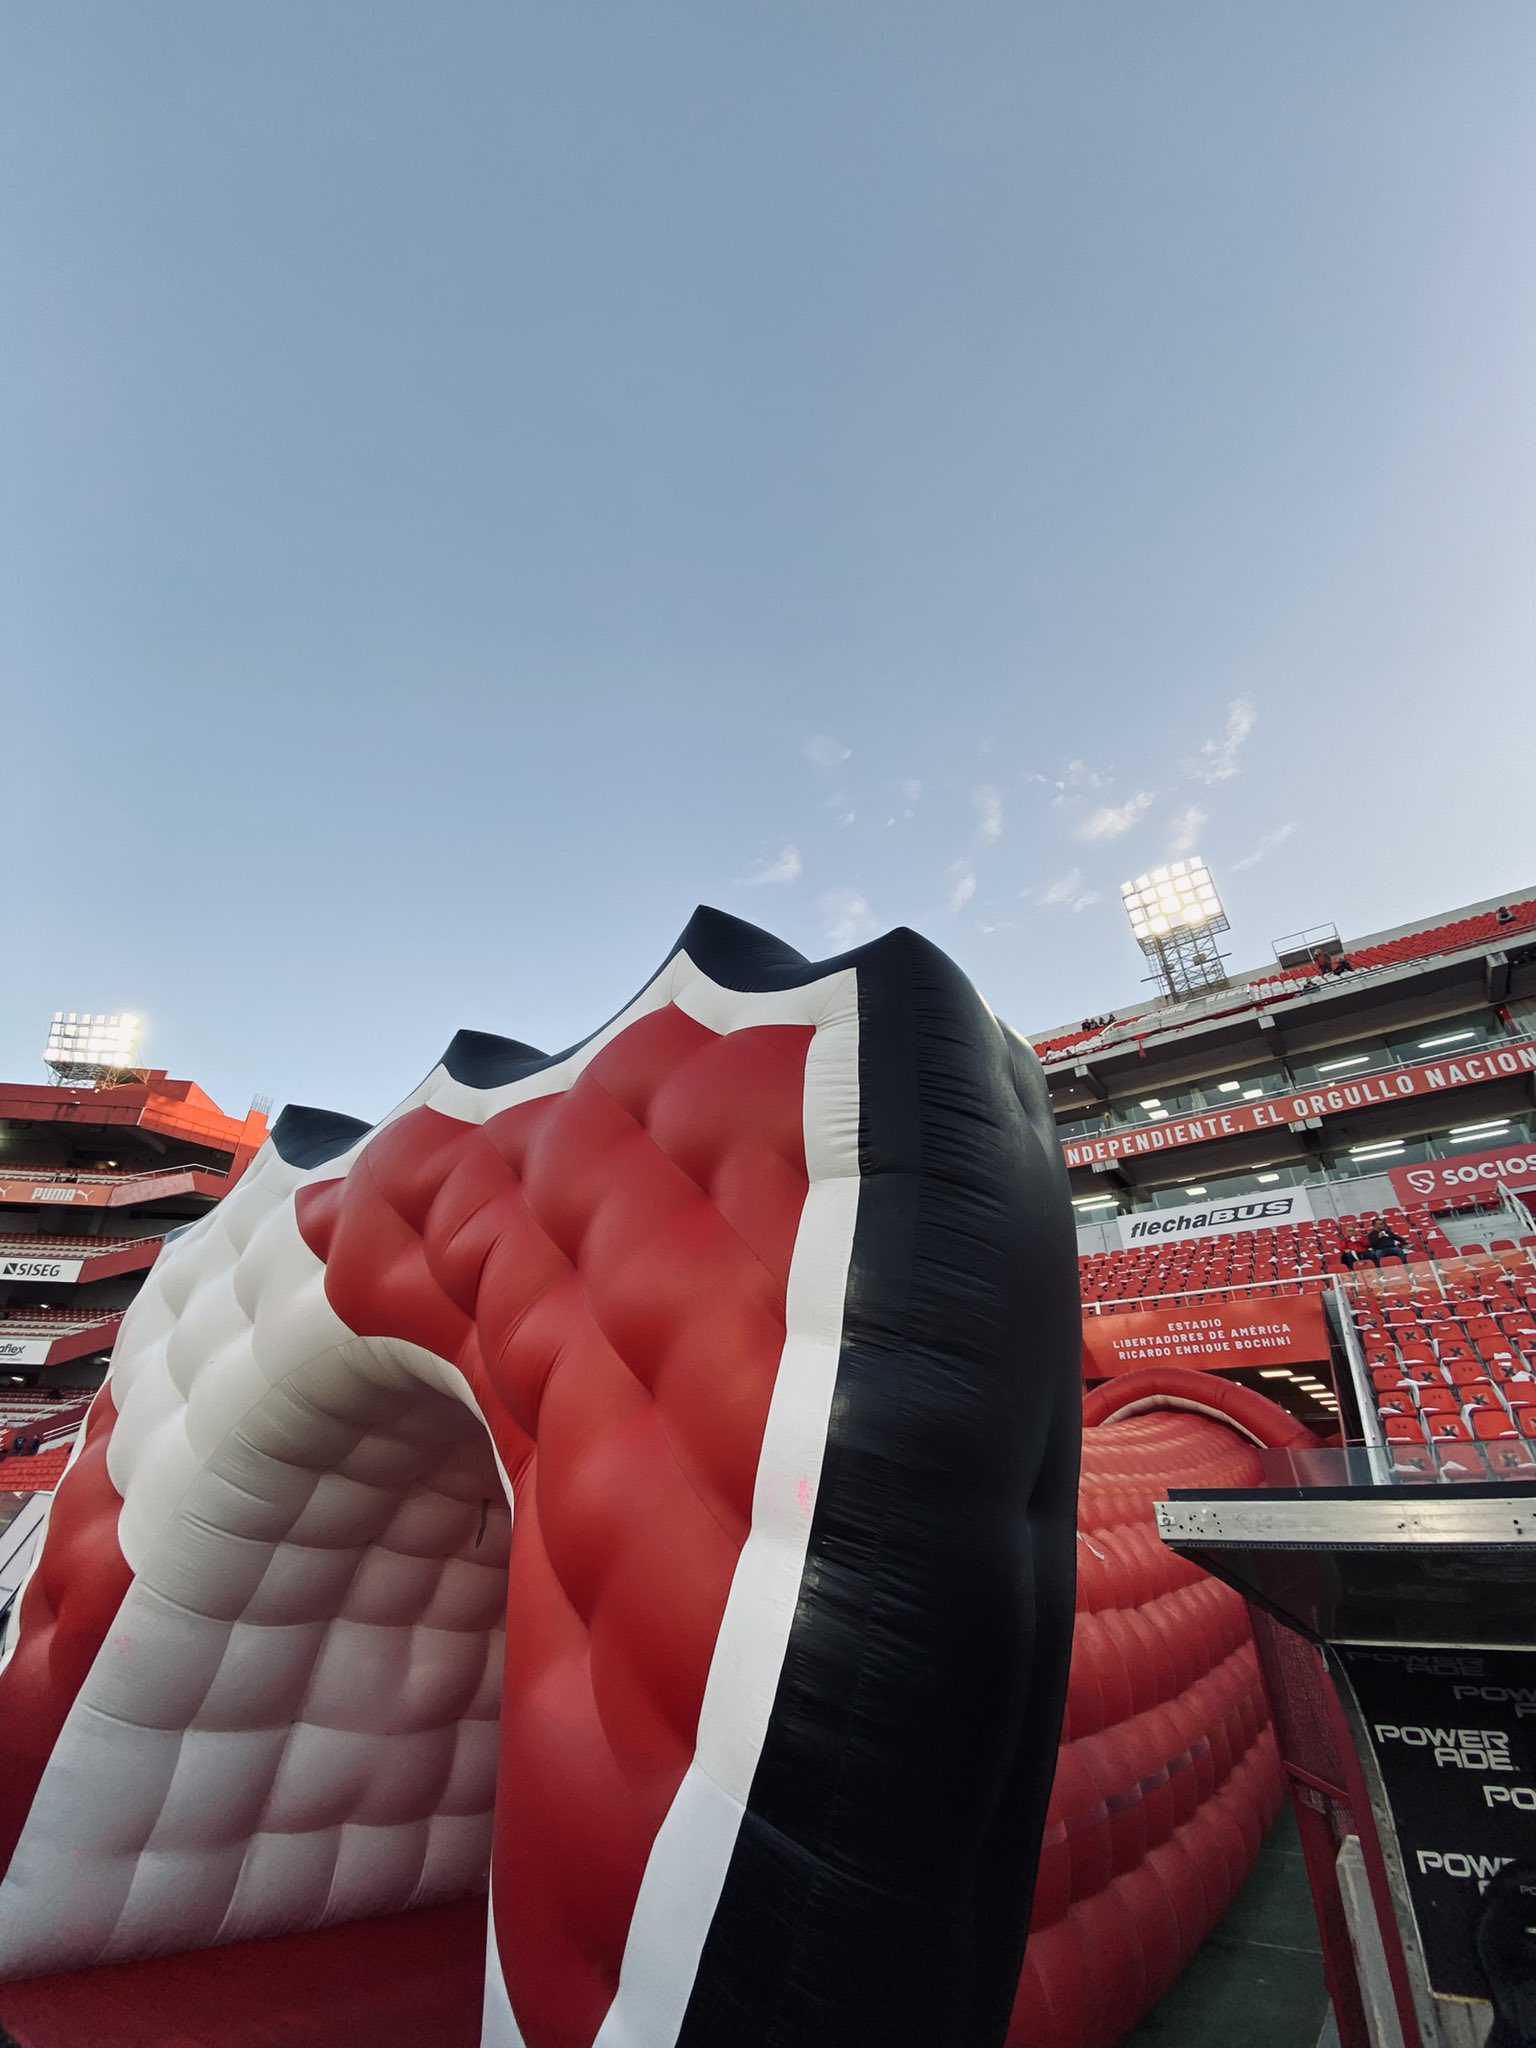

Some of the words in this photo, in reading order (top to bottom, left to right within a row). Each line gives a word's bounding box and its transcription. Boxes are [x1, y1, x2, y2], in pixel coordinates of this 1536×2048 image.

[1252, 1105, 1284, 1126] EL
[1293, 1075, 1414, 1117] ORGULLO
[31, 1187, 76, 1201] PUMA
[17, 1263, 61, 1277] SISEG
[1113, 1332, 1204, 1349] LIBERTADORES
[1209, 1329, 1224, 1340] DE
[1231, 1323, 1291, 1338] AMÉRICA
[1168, 1318, 1222, 1331] ESTADIO
[1119, 1347, 1171, 1360] RICARDO
[1176, 1342, 1230, 1355] ENRIQUE
[1235, 1336, 1291, 1350] BOCHINI
[1345, 1651, 1484, 1668] POWER
[1374, 1724, 1509, 1749] POWER
[1416, 1850, 1517, 1879] POW
